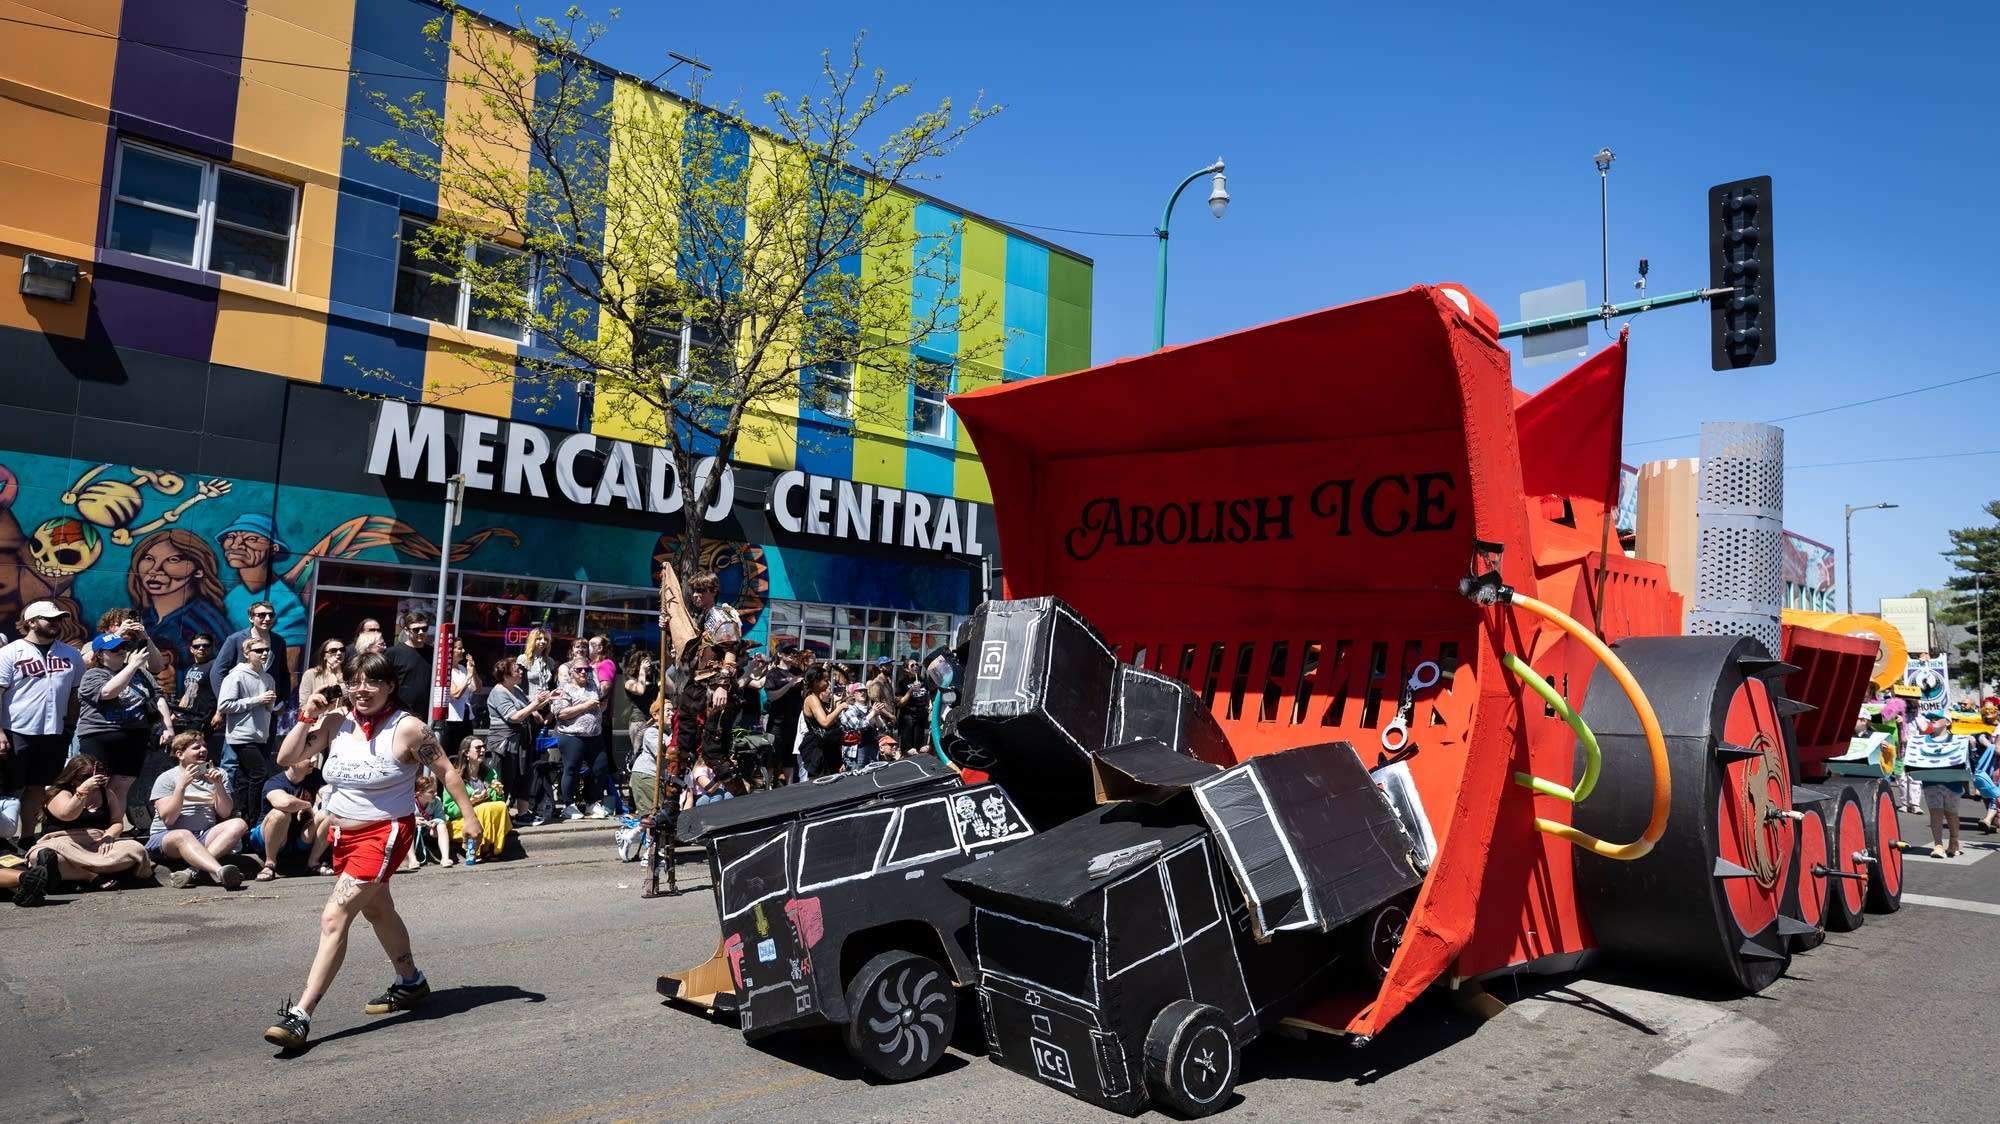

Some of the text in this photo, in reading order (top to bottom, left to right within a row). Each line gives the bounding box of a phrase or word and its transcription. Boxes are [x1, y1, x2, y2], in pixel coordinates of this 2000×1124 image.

[367, 399, 983, 556] MERCADO CENTRAL
[1065, 472, 1458, 561] ABOLISH ICE
[13, 655, 72, 678] Twins
[984, 647, 1002, 674] ICE
[1036, 1047, 1066, 1076] ICE
